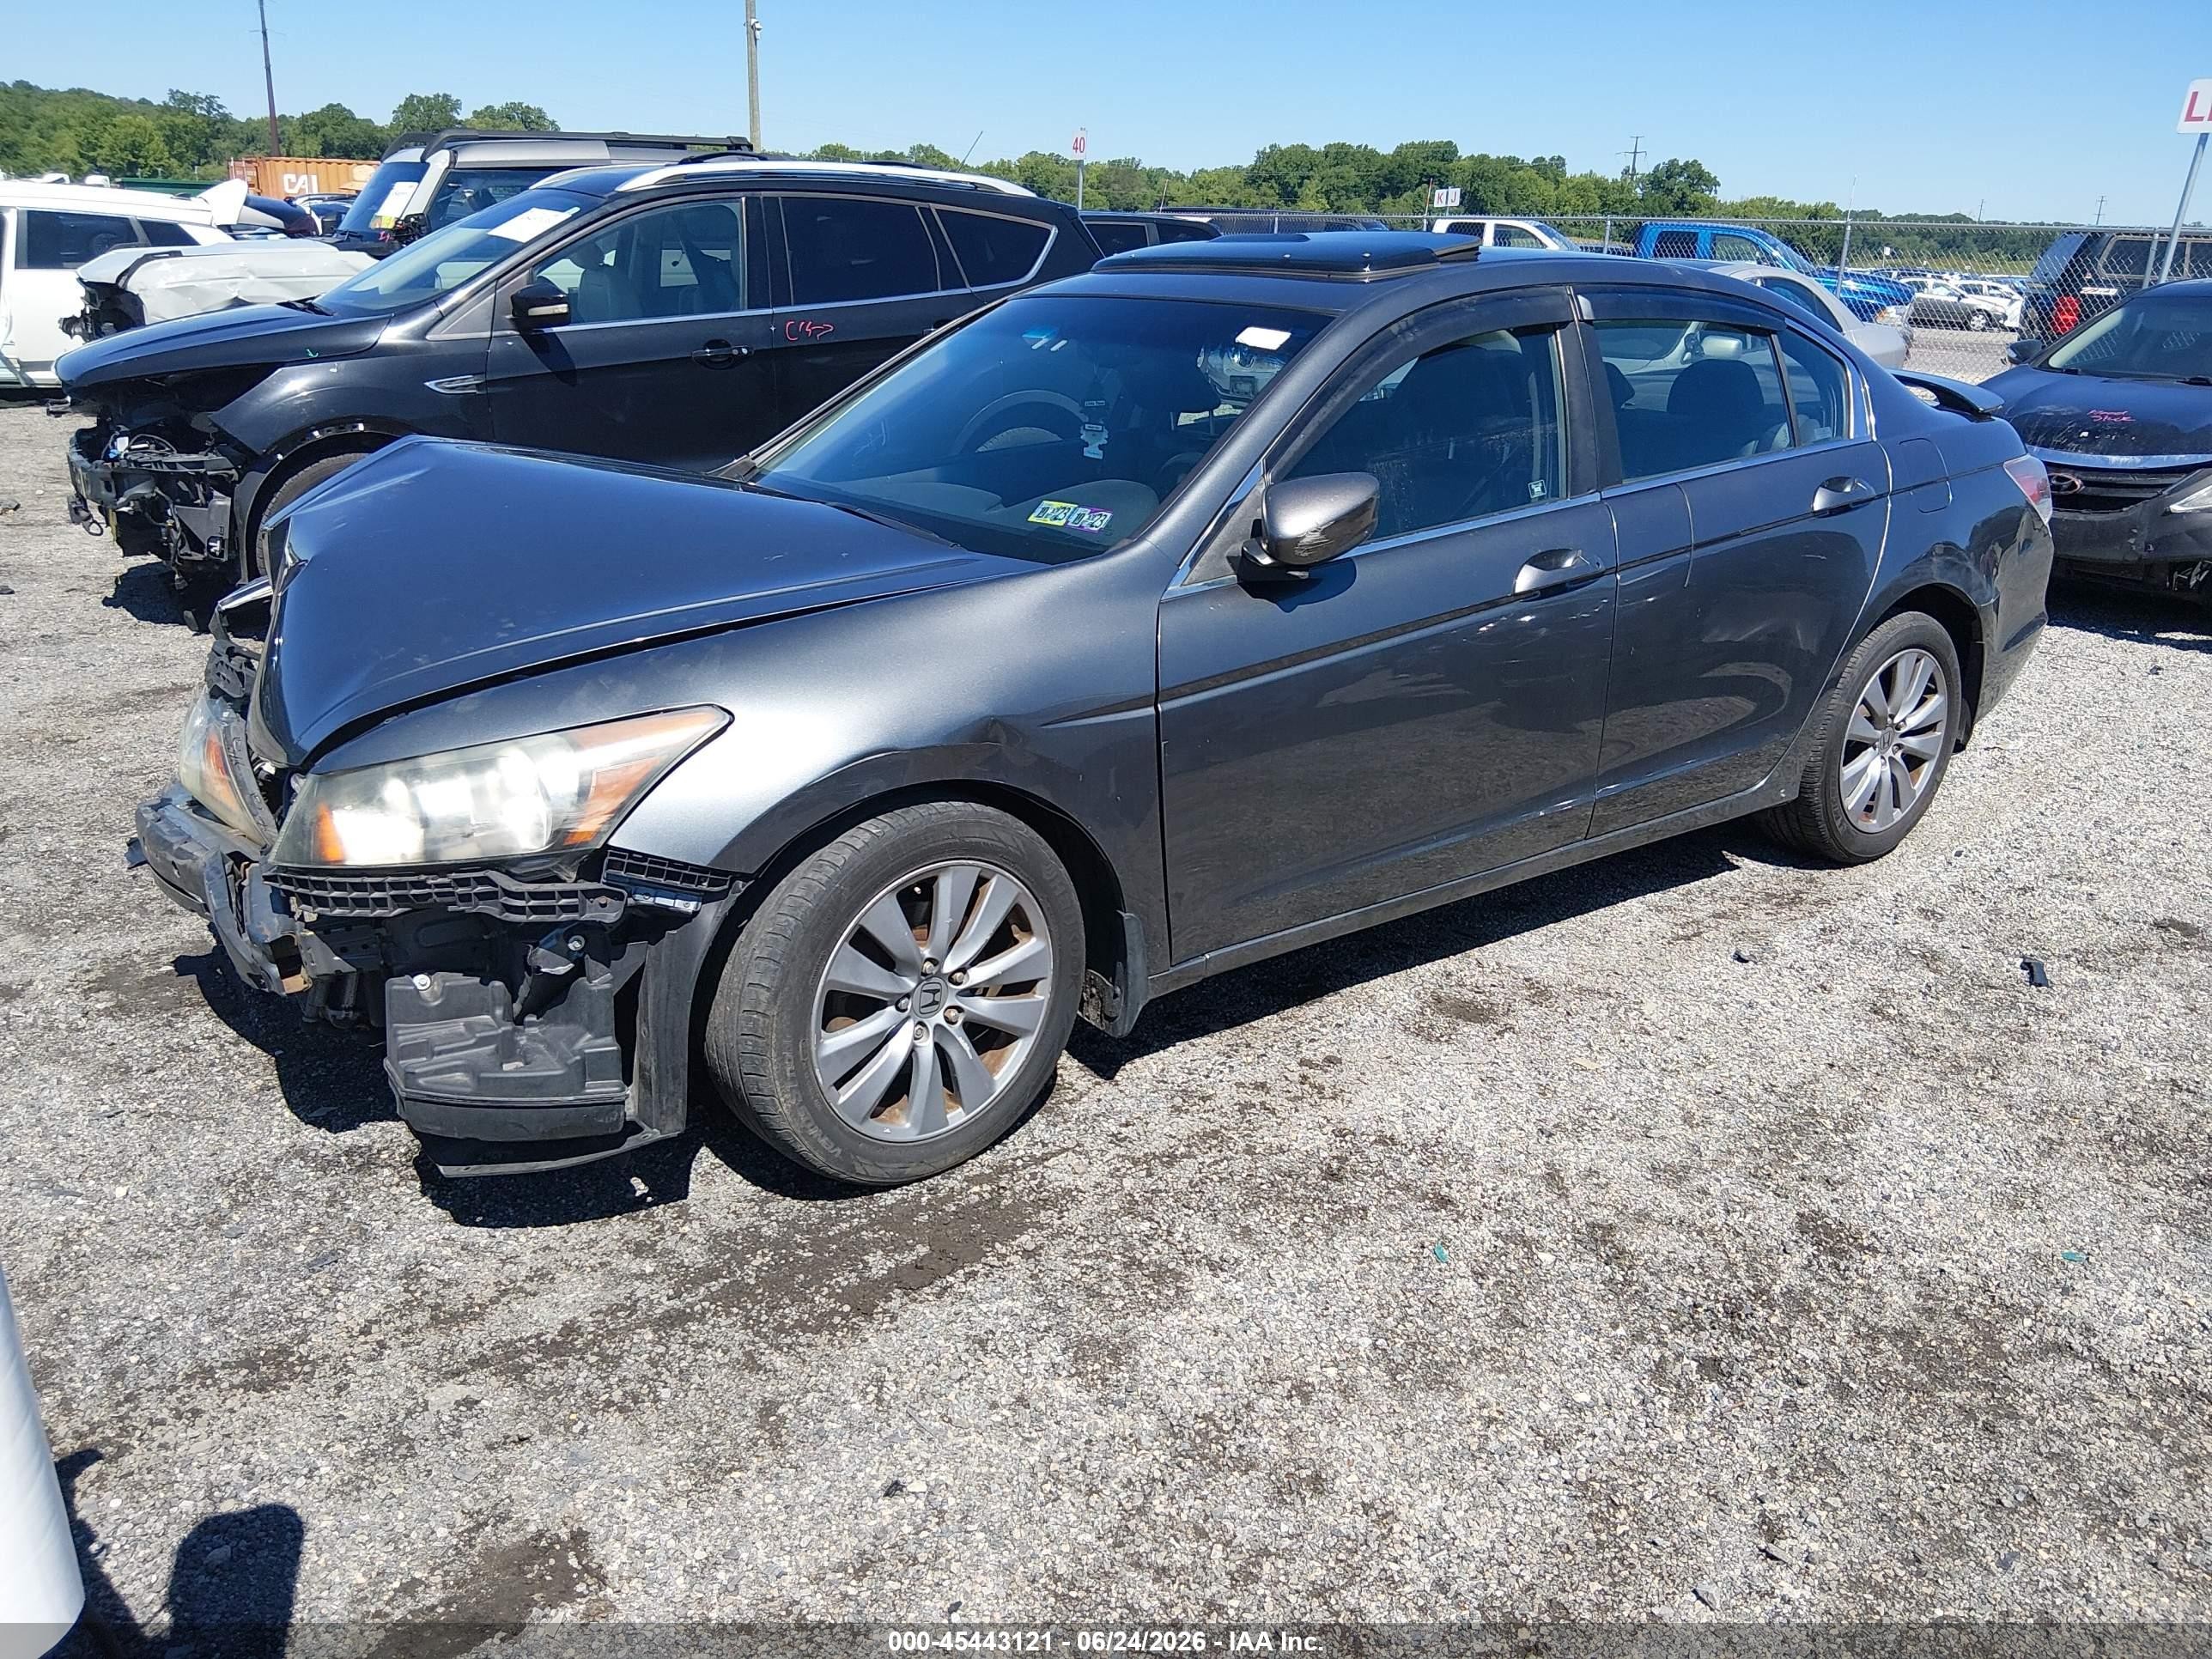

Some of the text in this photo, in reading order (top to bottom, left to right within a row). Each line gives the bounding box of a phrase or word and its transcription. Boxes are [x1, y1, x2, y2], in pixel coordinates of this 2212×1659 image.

[2184, 90, 2212, 122] L
[1073, 137, 1085, 153] 40
[1437, 191, 1457, 204] K J
[1054, 507, 1071, 520] 23
[1091, 513, 1108, 528] 23
